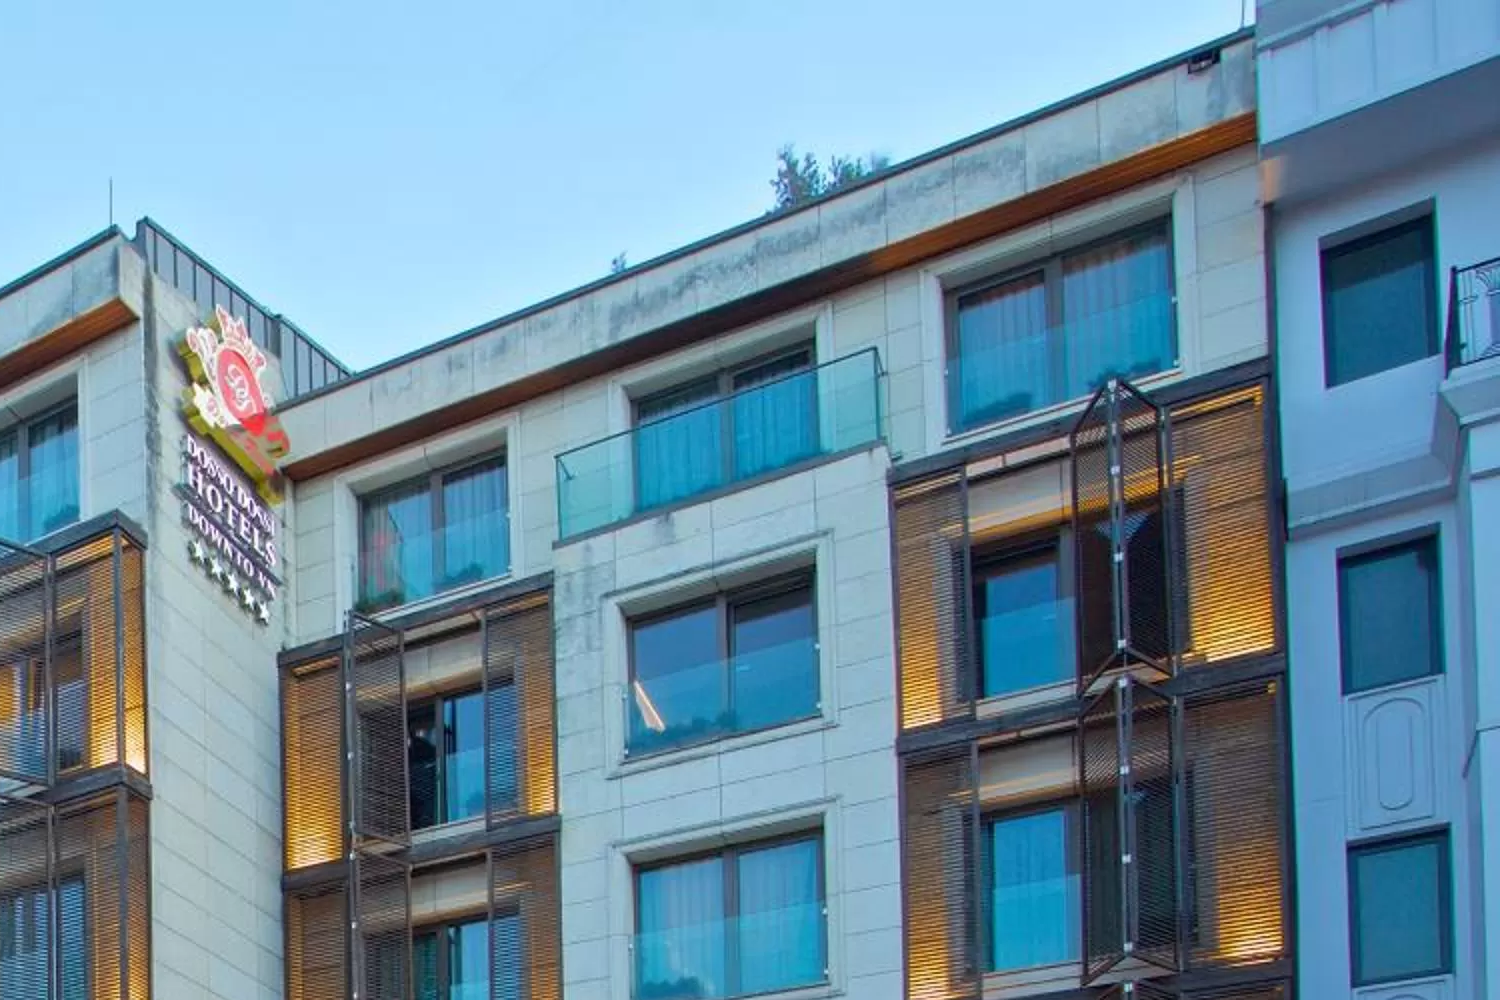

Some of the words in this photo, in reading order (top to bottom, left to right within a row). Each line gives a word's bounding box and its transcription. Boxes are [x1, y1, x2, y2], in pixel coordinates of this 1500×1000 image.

[187, 433, 234, 495] DOSSO
[238, 486, 275, 537] DOSSI
[188, 462, 277, 567] HOTELS
